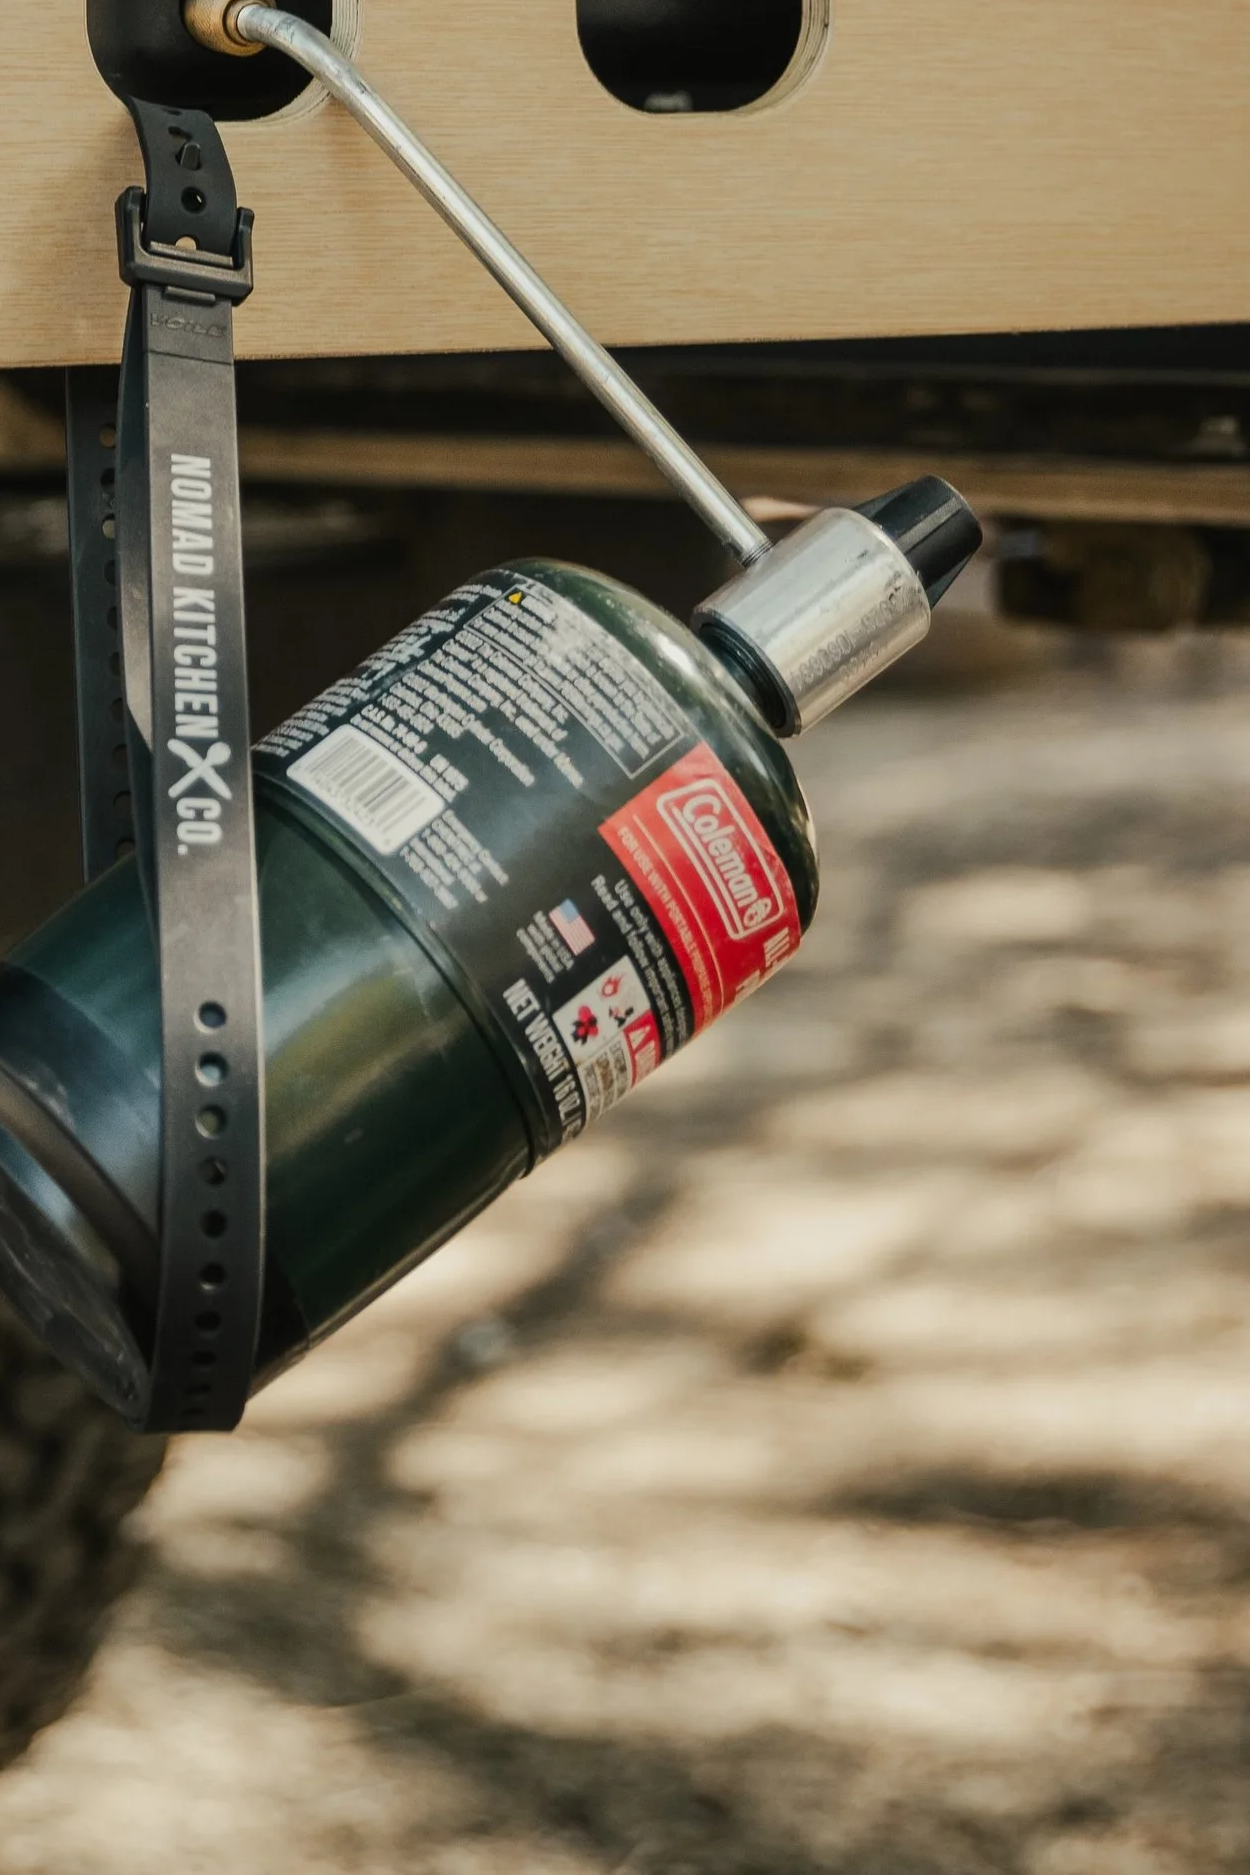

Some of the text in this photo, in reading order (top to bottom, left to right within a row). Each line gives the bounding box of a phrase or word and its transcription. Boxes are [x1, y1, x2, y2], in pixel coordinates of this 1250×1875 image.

[170, 453, 223, 856] NOMAD KITCHEN CO.
[615, 825, 639, 853] FOR
[630, 847, 653, 875] USE
[646, 870, 672, 904] WITH
[681, 790, 758, 910] Coleman
[589, 874, 620, 911] Read
[611, 878, 637, 908] Use
[500, 978, 541, 1021] NET
[520, 1014, 572, 1082] WEIGHT
[551, 1072, 577, 1101] 16
